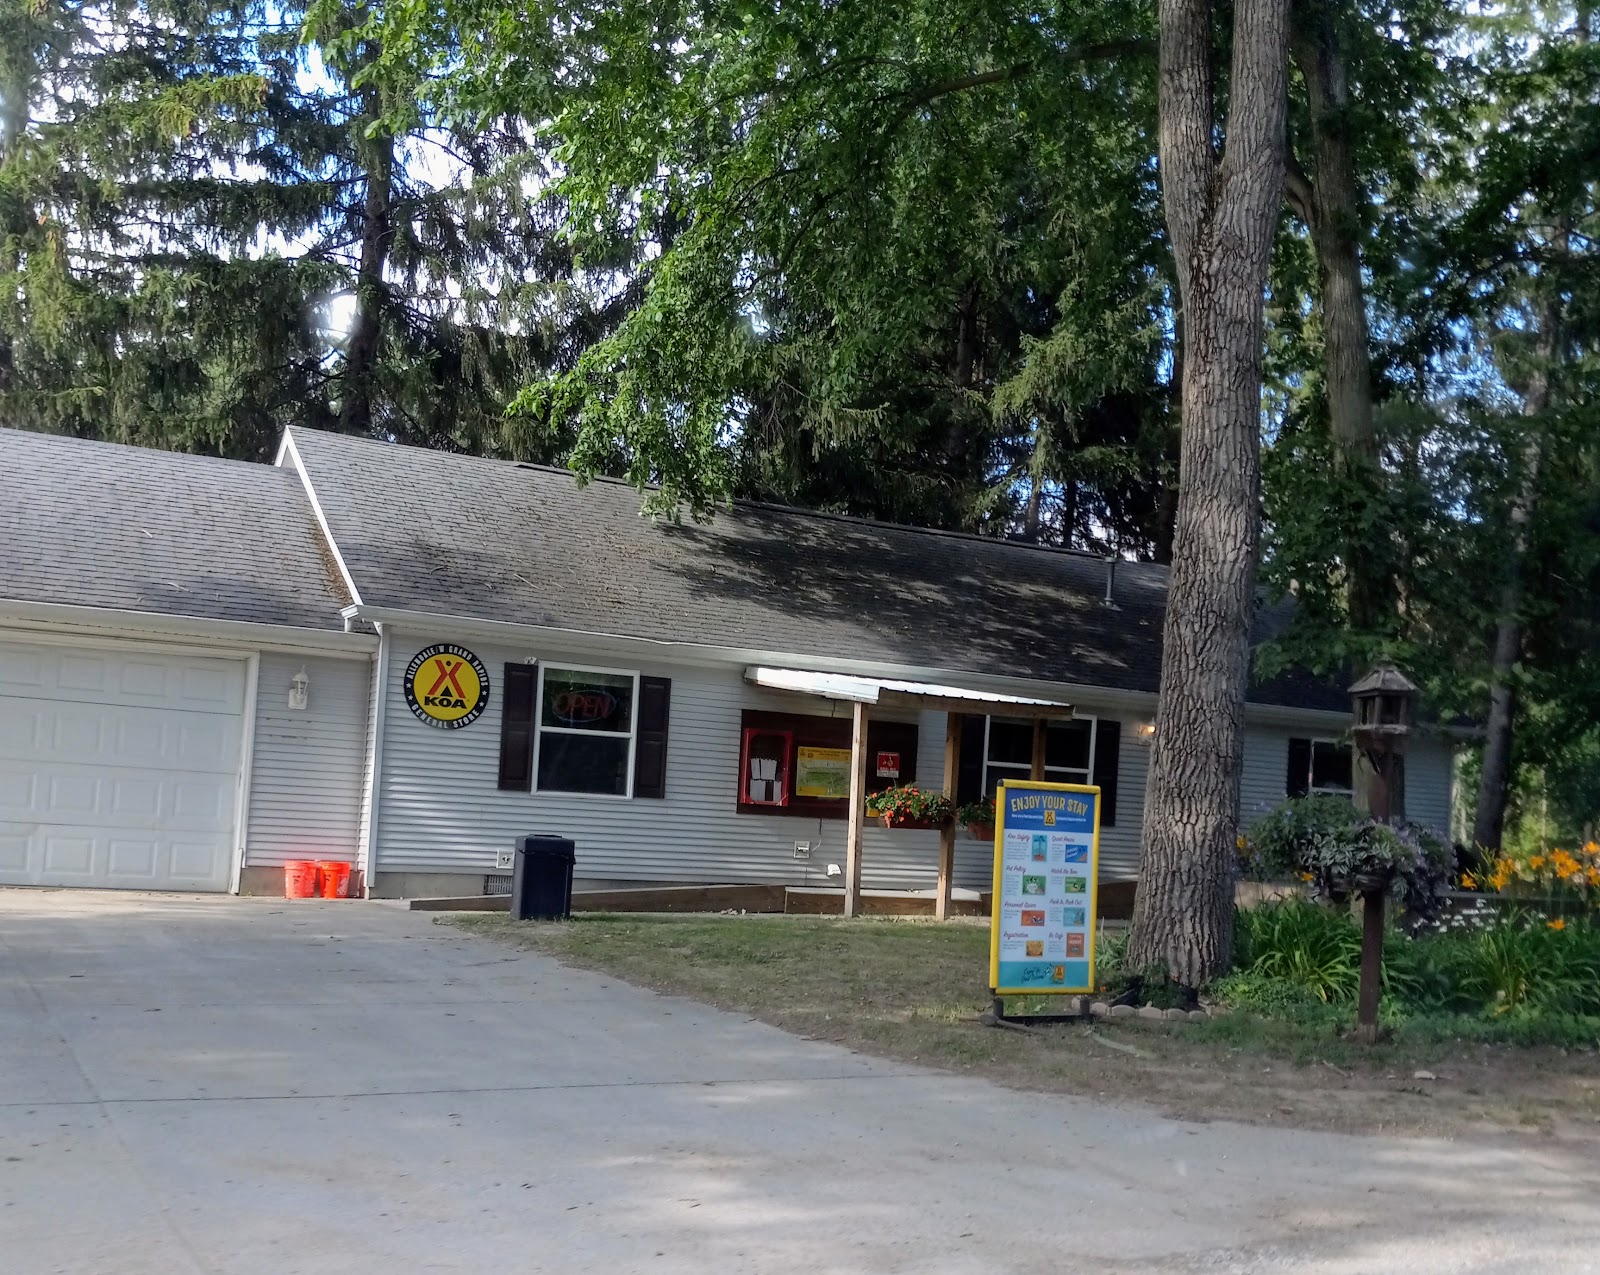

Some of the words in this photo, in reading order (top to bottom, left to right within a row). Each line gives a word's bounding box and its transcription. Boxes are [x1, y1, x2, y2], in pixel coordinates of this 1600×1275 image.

[448, 645, 473, 661] GRAND
[472, 660, 489, 687] RAPIDS
[424, 695, 468, 710] KOA
[555, 694, 611, 719] OPEN
[411, 703, 448, 729] GENERAL
[452, 709, 480, 729] STORE
[1011, 795, 1041, 812] ENJOY
[1041, 795, 1066, 811] YOUR
[1067, 799, 1088, 816] STAY
[1013, 865, 1026, 874] Policy
[1003, 931, 1029, 940] Registration
